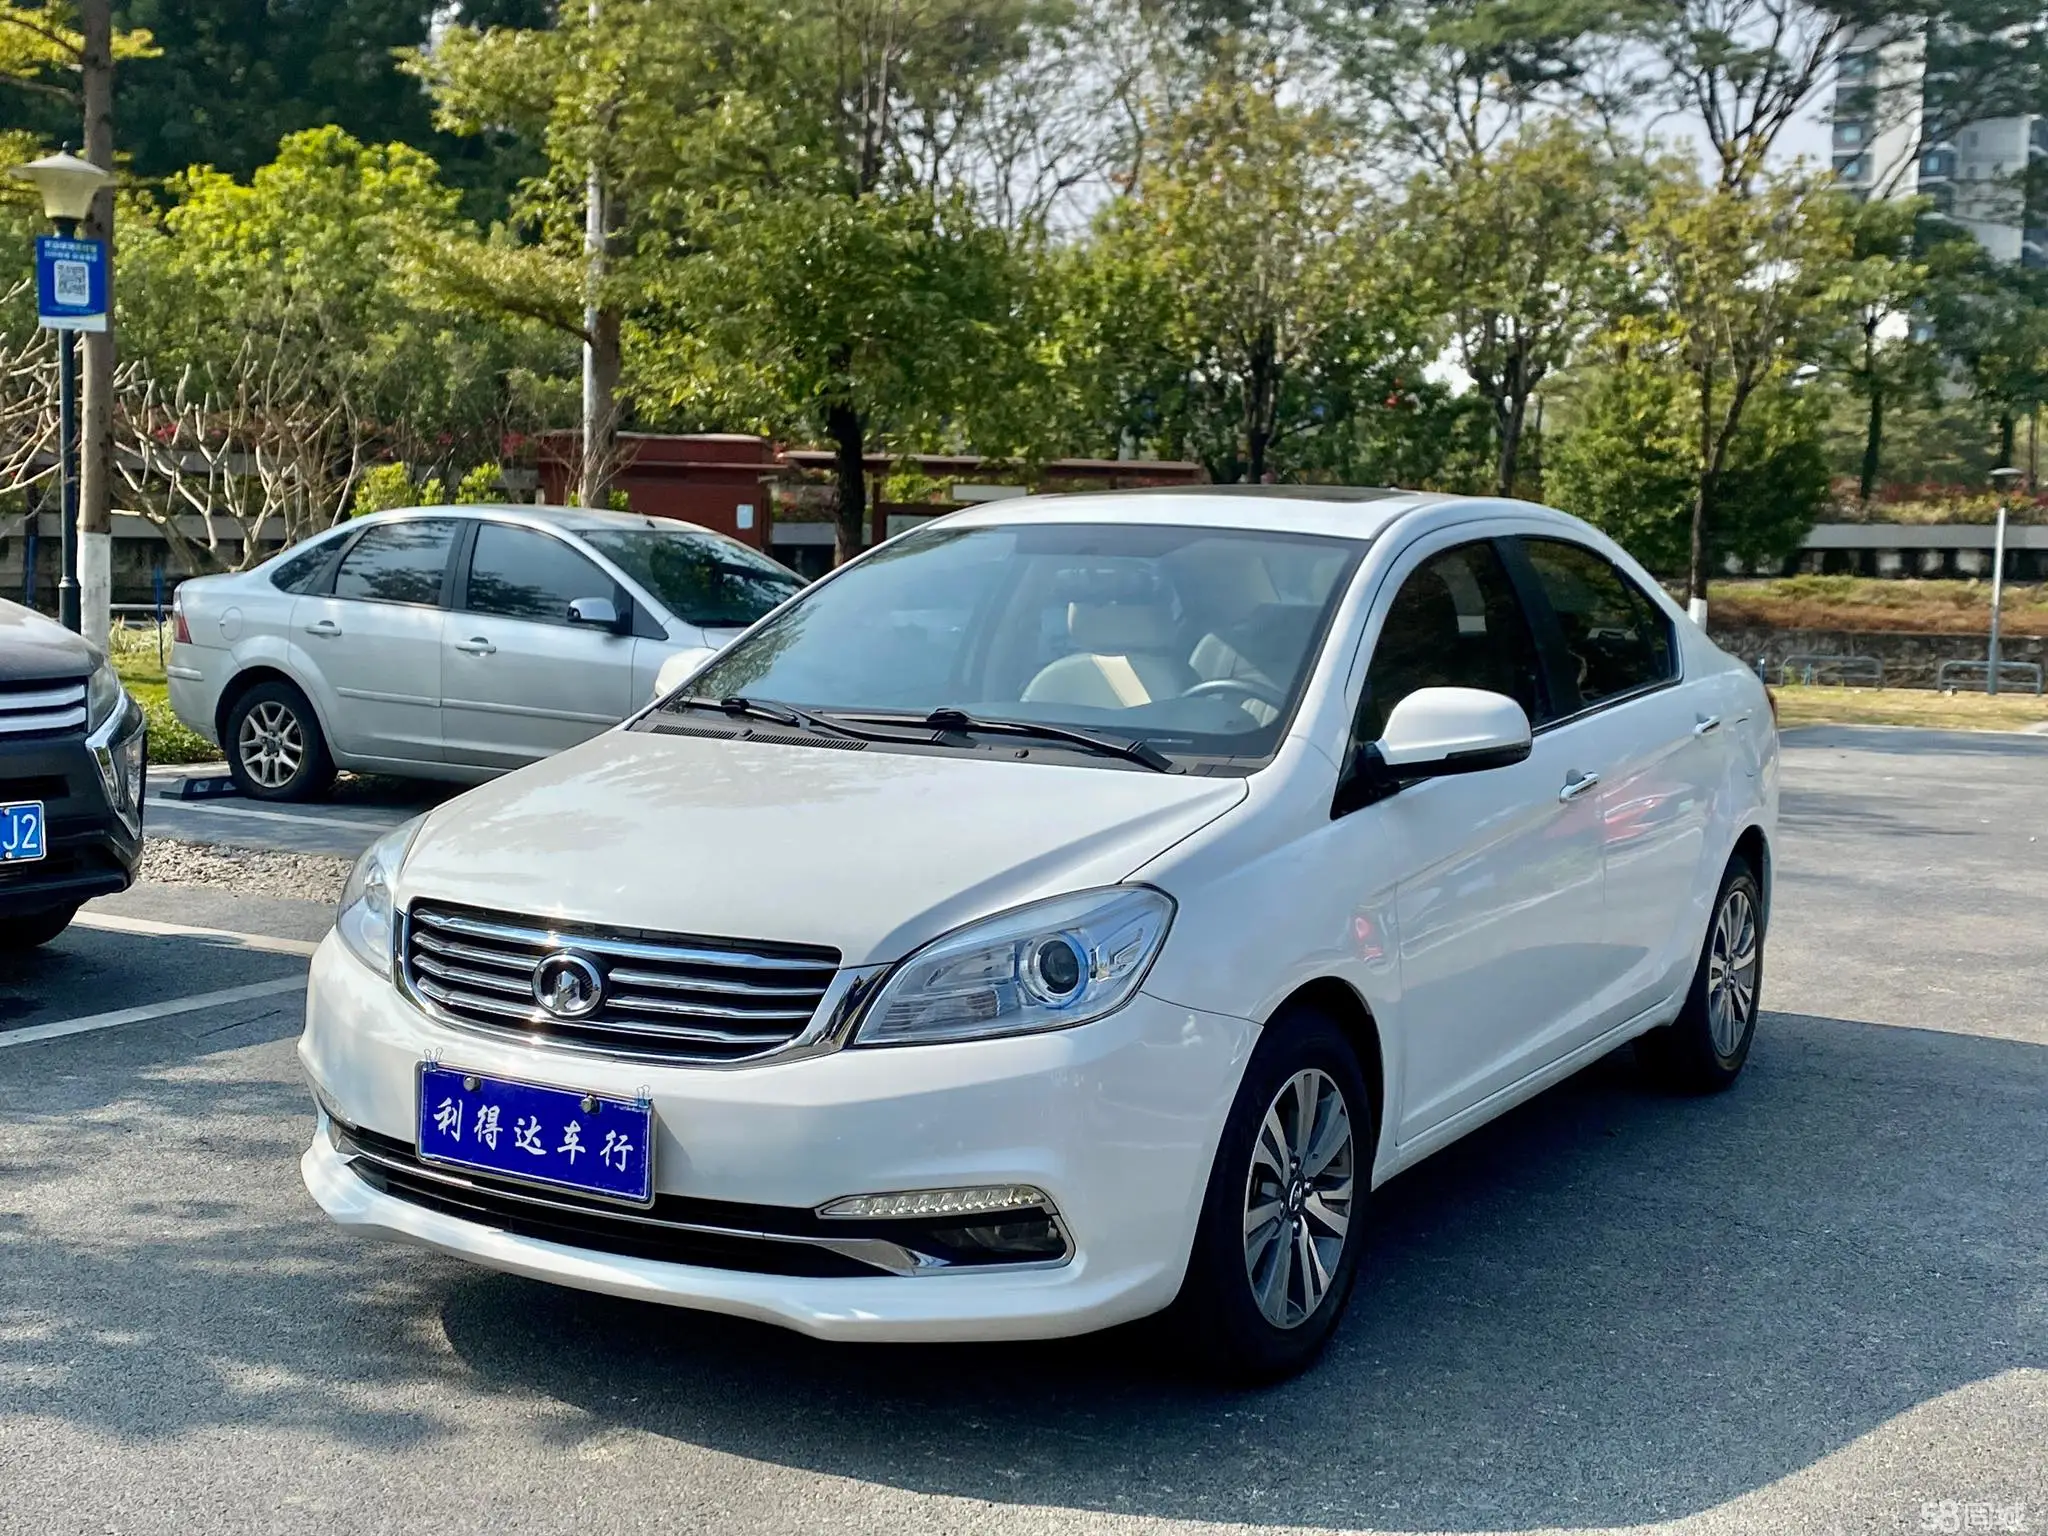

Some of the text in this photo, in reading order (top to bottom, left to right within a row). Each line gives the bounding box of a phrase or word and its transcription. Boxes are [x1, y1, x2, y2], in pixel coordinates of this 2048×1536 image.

[2, 813, 38, 850] J2
[433, 1097, 634, 1173] 利得达车行
